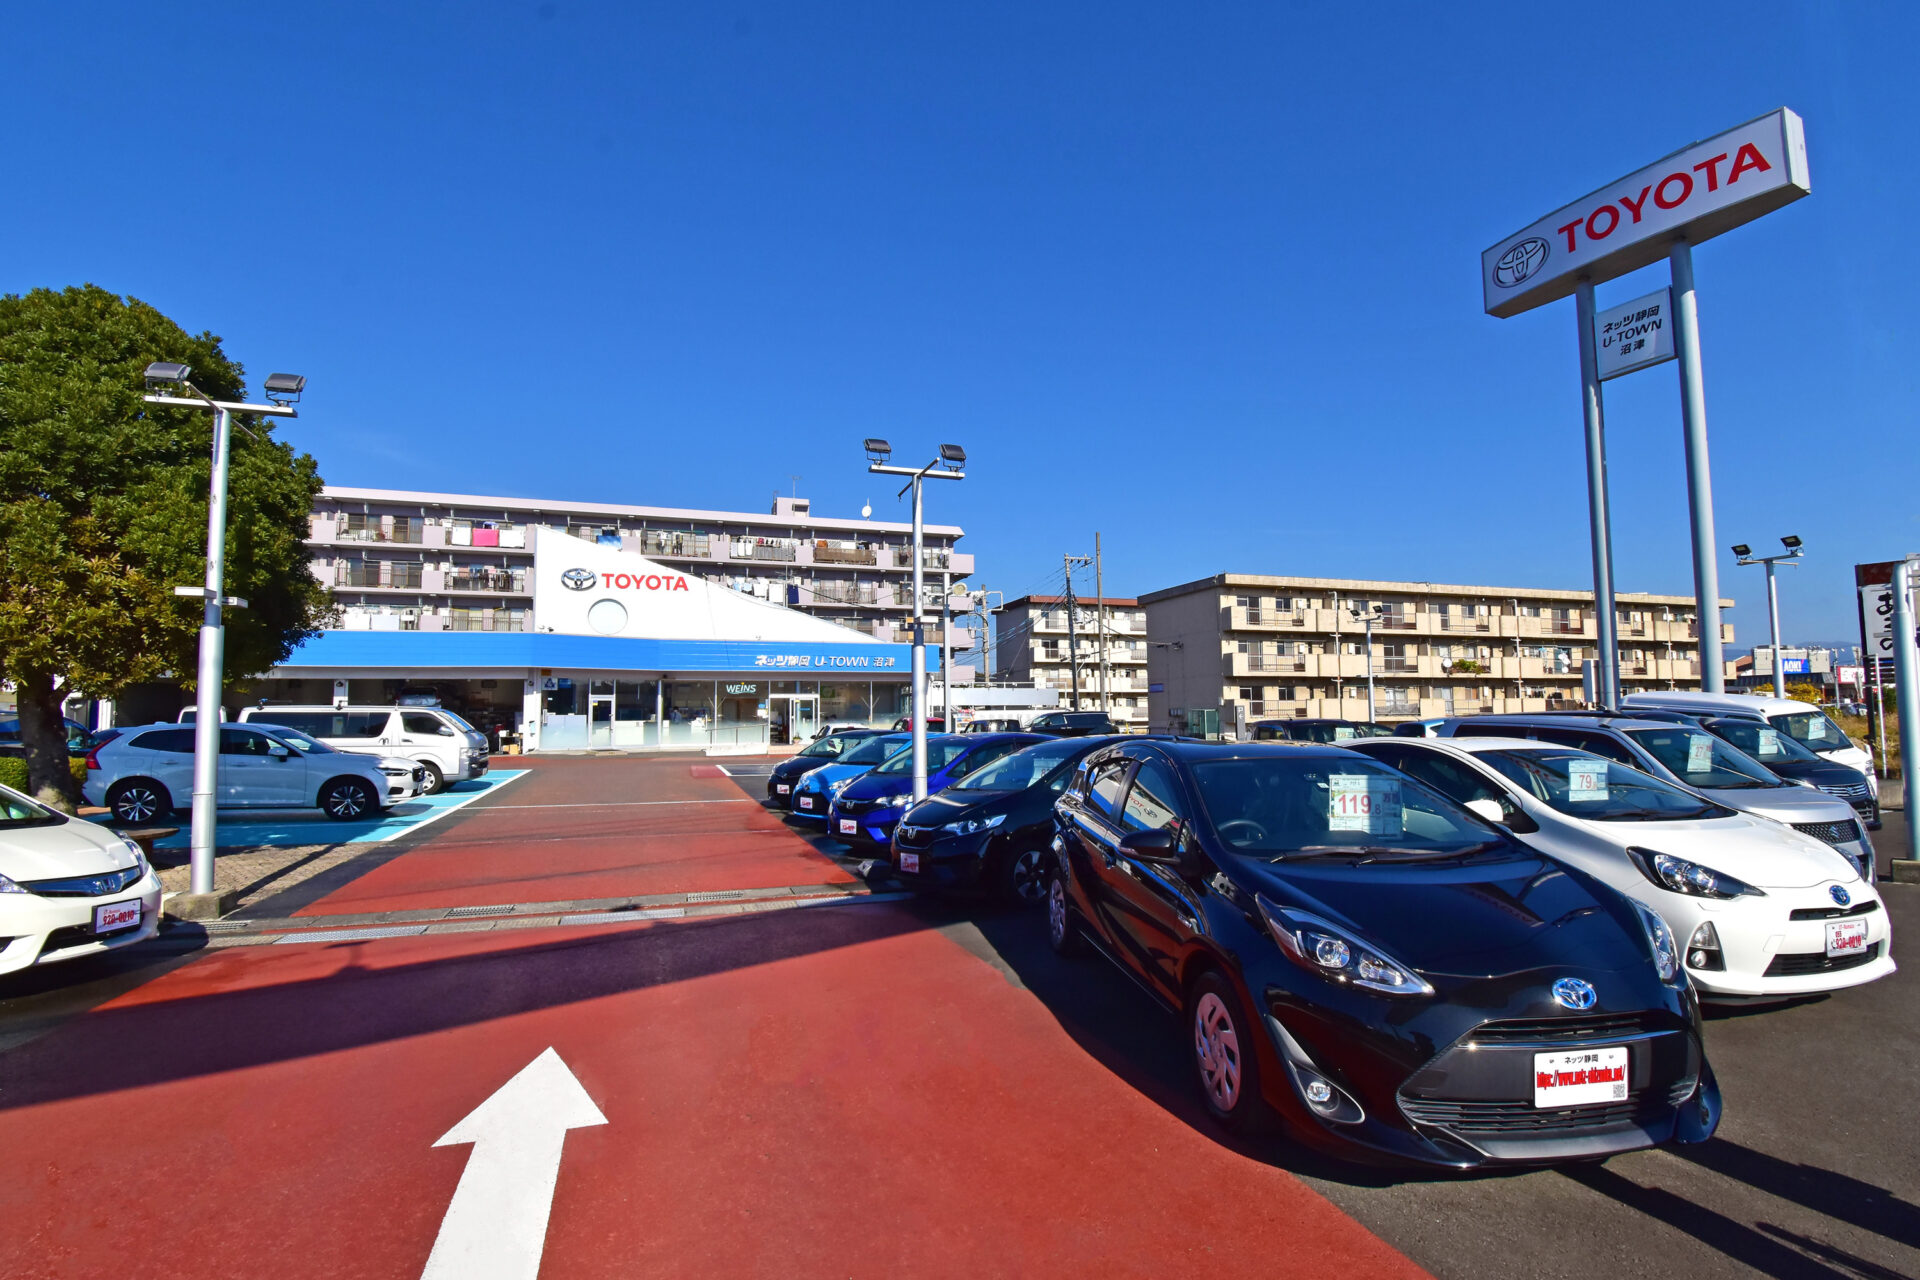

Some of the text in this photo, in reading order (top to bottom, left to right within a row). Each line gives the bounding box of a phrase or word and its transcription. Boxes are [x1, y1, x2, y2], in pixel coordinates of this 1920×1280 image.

[1557, 142, 1772, 254] TOYOTA
[1603, 305, 1660, 333] ネッツ静岡
[1603, 318, 1662, 348] U-TOWN
[1620, 338, 1645, 356] 沼津
[601, 573, 689, 591] TOYOTA
[755, 655, 811, 667] ネッツ静岡
[814, 656, 869, 668] U-TOWN
[1783, 660, 1802, 672] AOKI
[1564, 1054, 1599, 1064] ネッツ静岡
